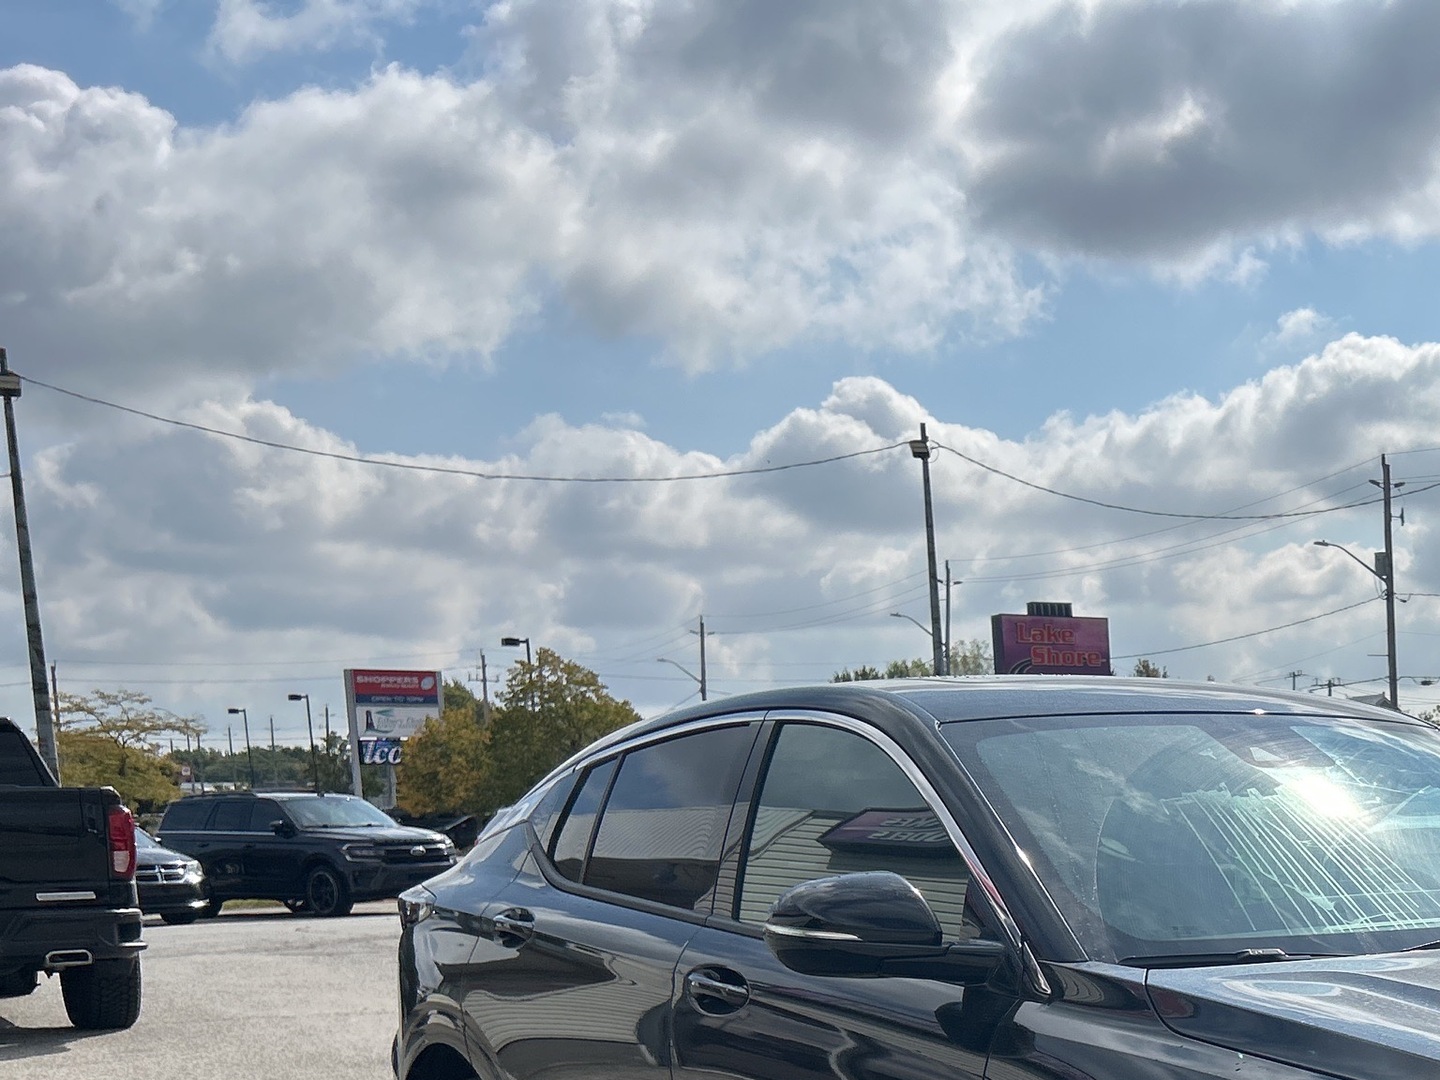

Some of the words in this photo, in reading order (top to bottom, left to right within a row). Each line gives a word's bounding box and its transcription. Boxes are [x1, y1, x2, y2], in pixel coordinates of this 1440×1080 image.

[1016, 622, 1075, 644] Lake
[1031, 645, 1101, 667] Shore
[356, 675, 418, 684] SHOPPERS
